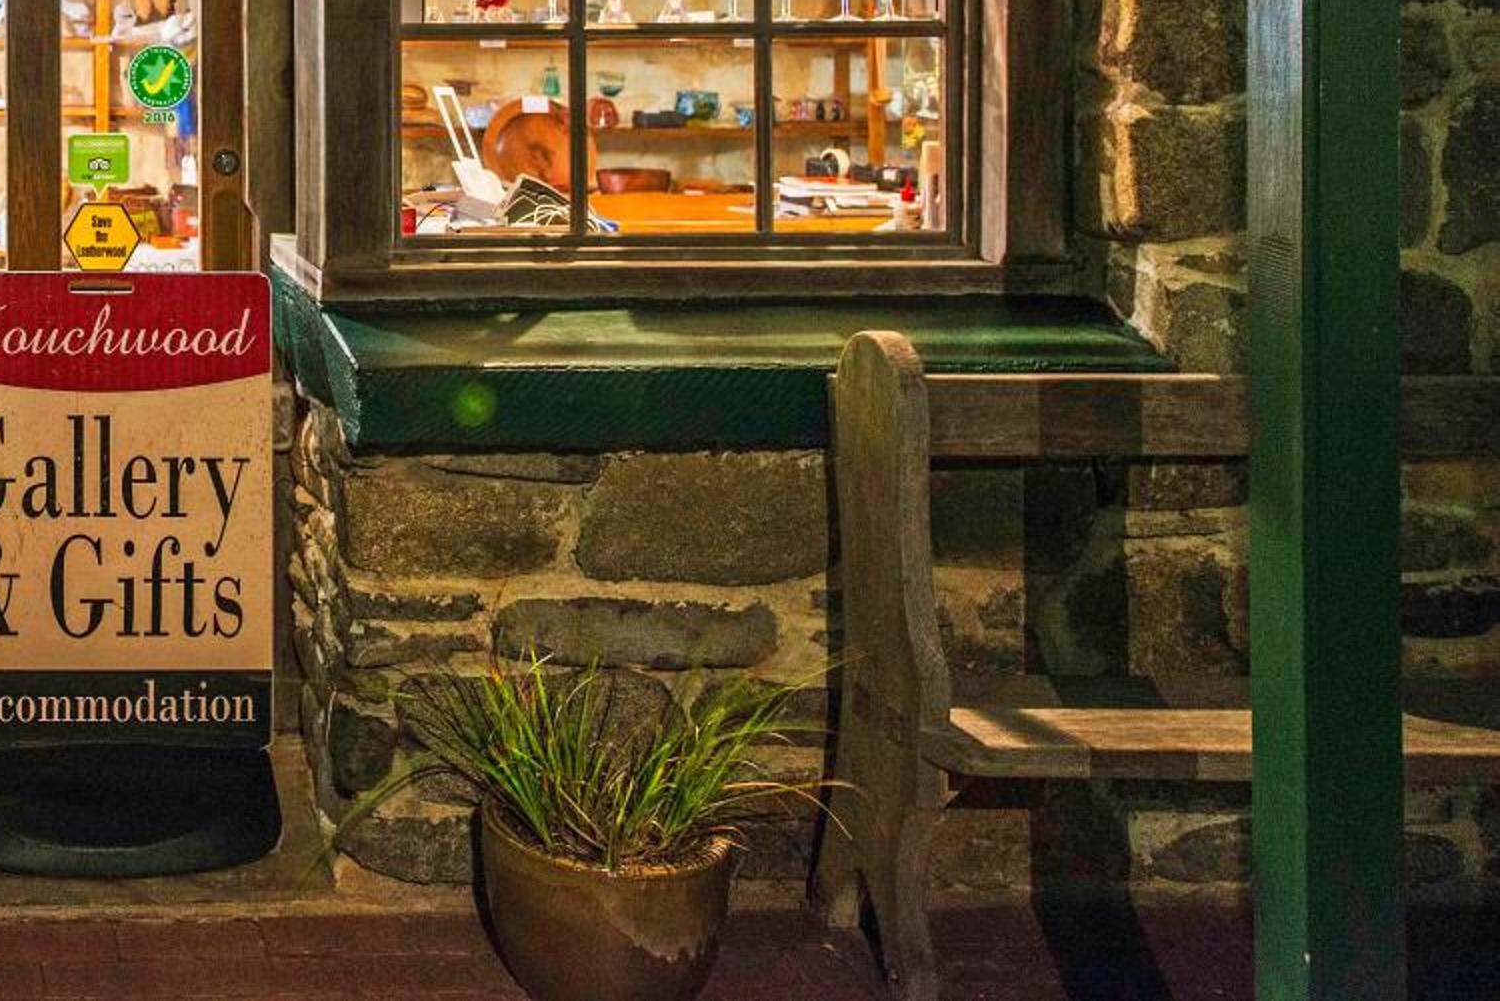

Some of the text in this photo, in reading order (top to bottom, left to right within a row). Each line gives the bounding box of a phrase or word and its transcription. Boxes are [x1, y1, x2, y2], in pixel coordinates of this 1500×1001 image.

[145, 111, 176, 123] 2016
[91, 214, 113, 228] Save
[49, 534, 245, 639] Gifts
